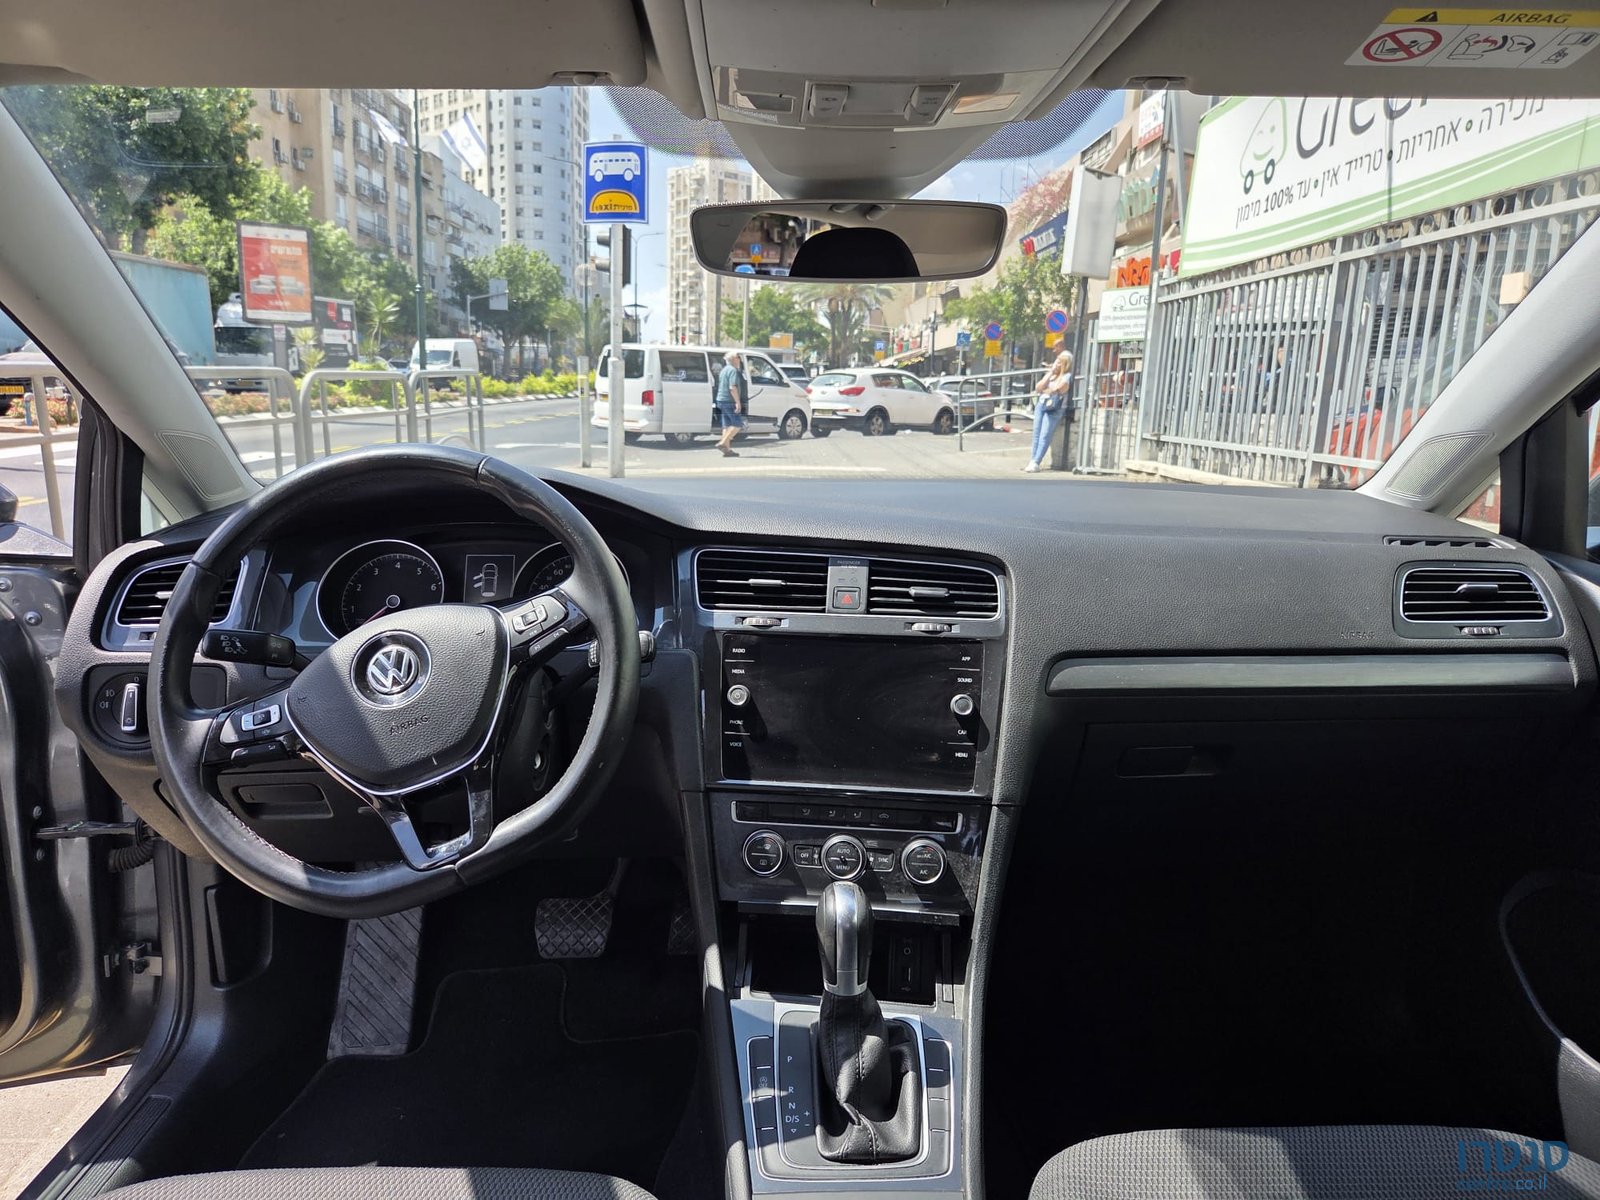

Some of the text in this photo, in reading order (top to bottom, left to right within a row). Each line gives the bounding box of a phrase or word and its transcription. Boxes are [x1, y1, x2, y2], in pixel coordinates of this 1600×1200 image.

[1489, 13, 1572, 24] AIRBAG
[1396, 117, 1462, 163] אחריות
[1345, 148, 1383, 181] טרייד
[1321, 165, 1341, 197] אין
[1297, 178, 1312, 200] עד
[1263, 185, 1294, 213] 100%
[1235, 199, 1261, 229] מימון
[395, 561, 401, 569] 4
[373, 568, 379, 576] 3
[416, 567, 422, 575] 5
[553, 568, 564, 576] 60
[356, 583, 362, 592] 2
[430, 583, 437, 591] 6
[389, 714, 429, 736] AIRBAG
[787, 1055, 793, 1063] P
[788, 1102, 796, 1110] N
[785, 1115, 800, 1123] D/S
